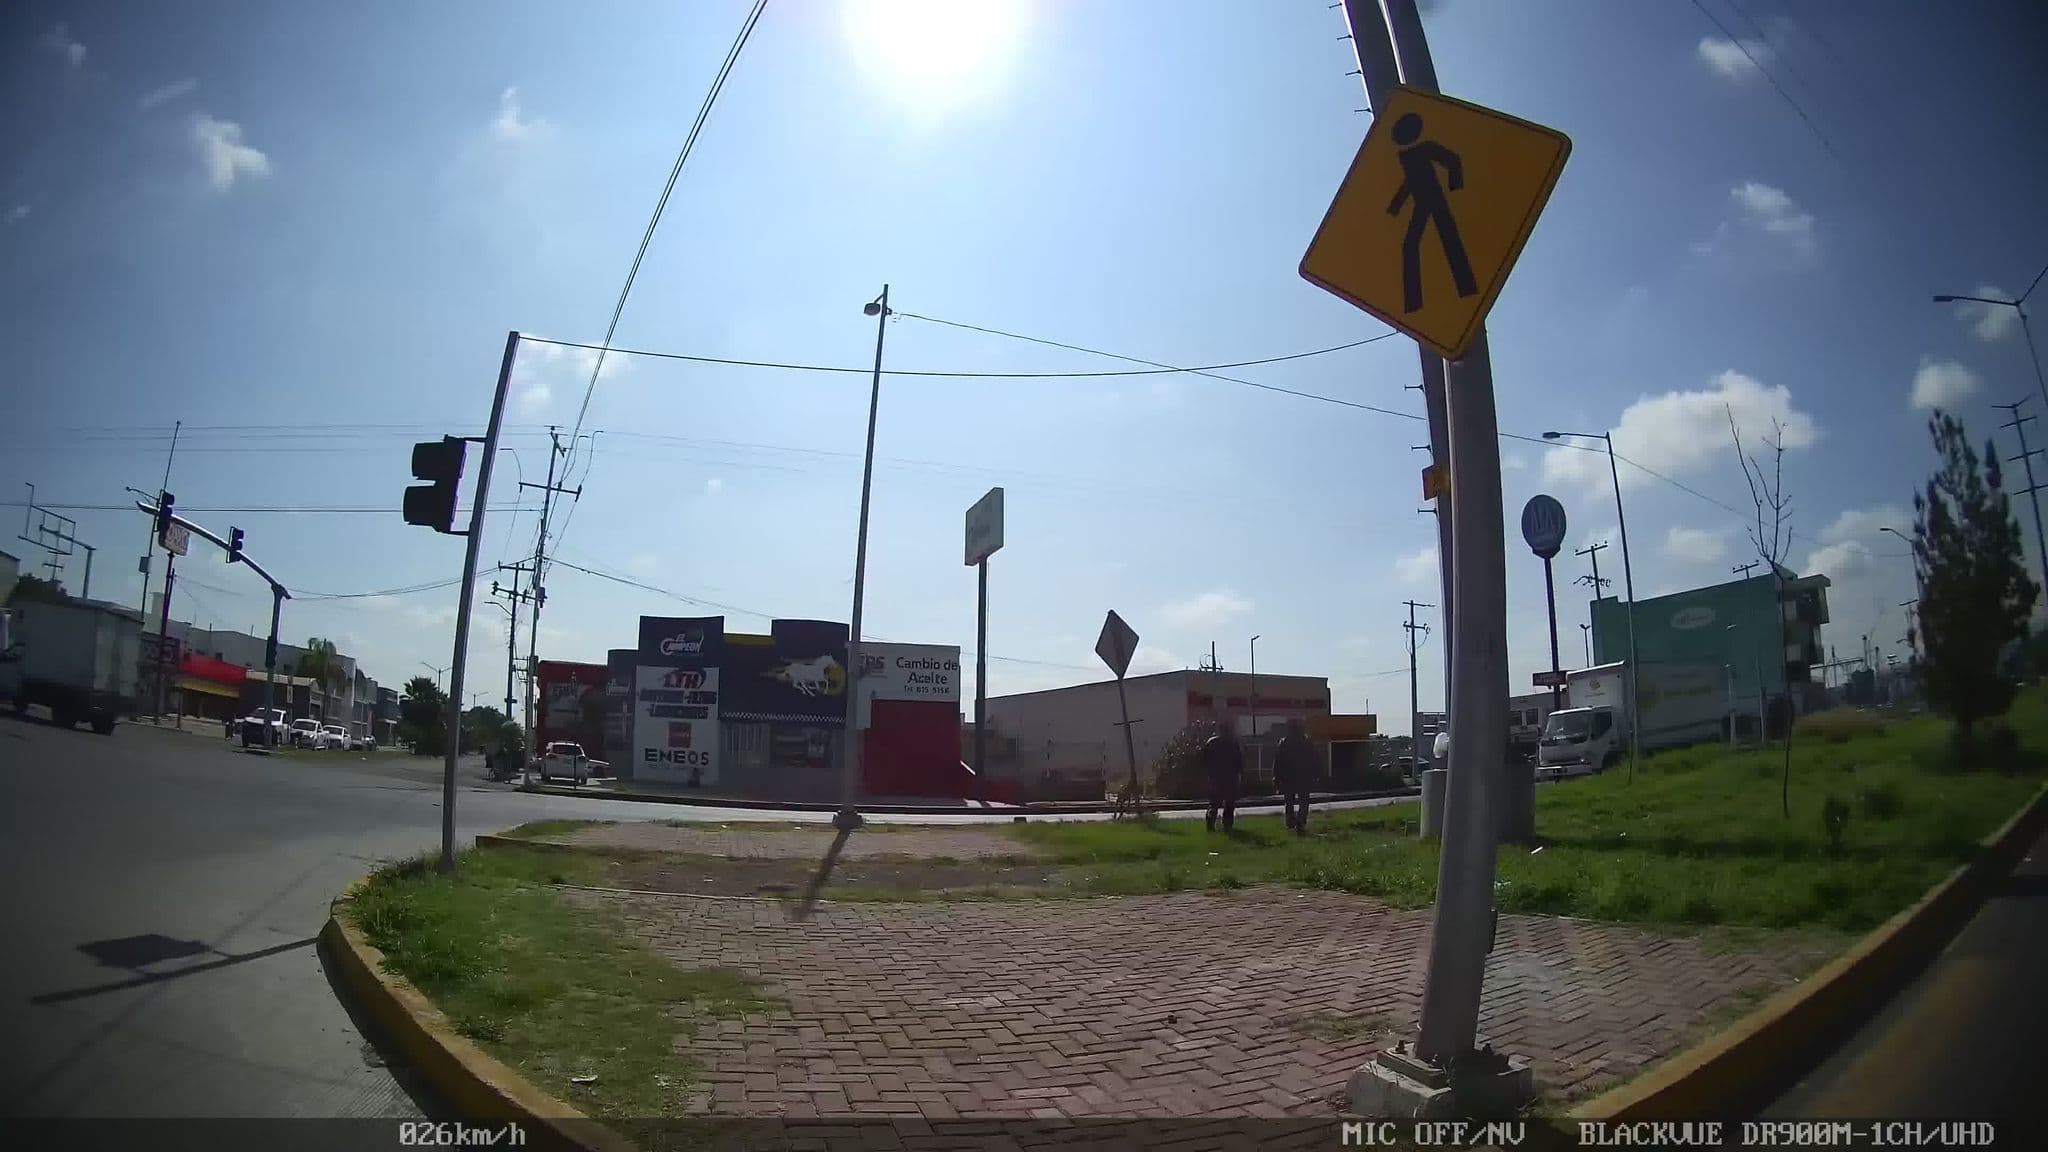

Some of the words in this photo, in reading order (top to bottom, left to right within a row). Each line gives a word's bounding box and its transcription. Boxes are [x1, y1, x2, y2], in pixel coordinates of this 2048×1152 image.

[896, 657, 940, 670] Cambio
[943, 659, 958, 671] de
[906, 672, 948, 684] Aceite
[644, 748, 710, 766] ENEOS
